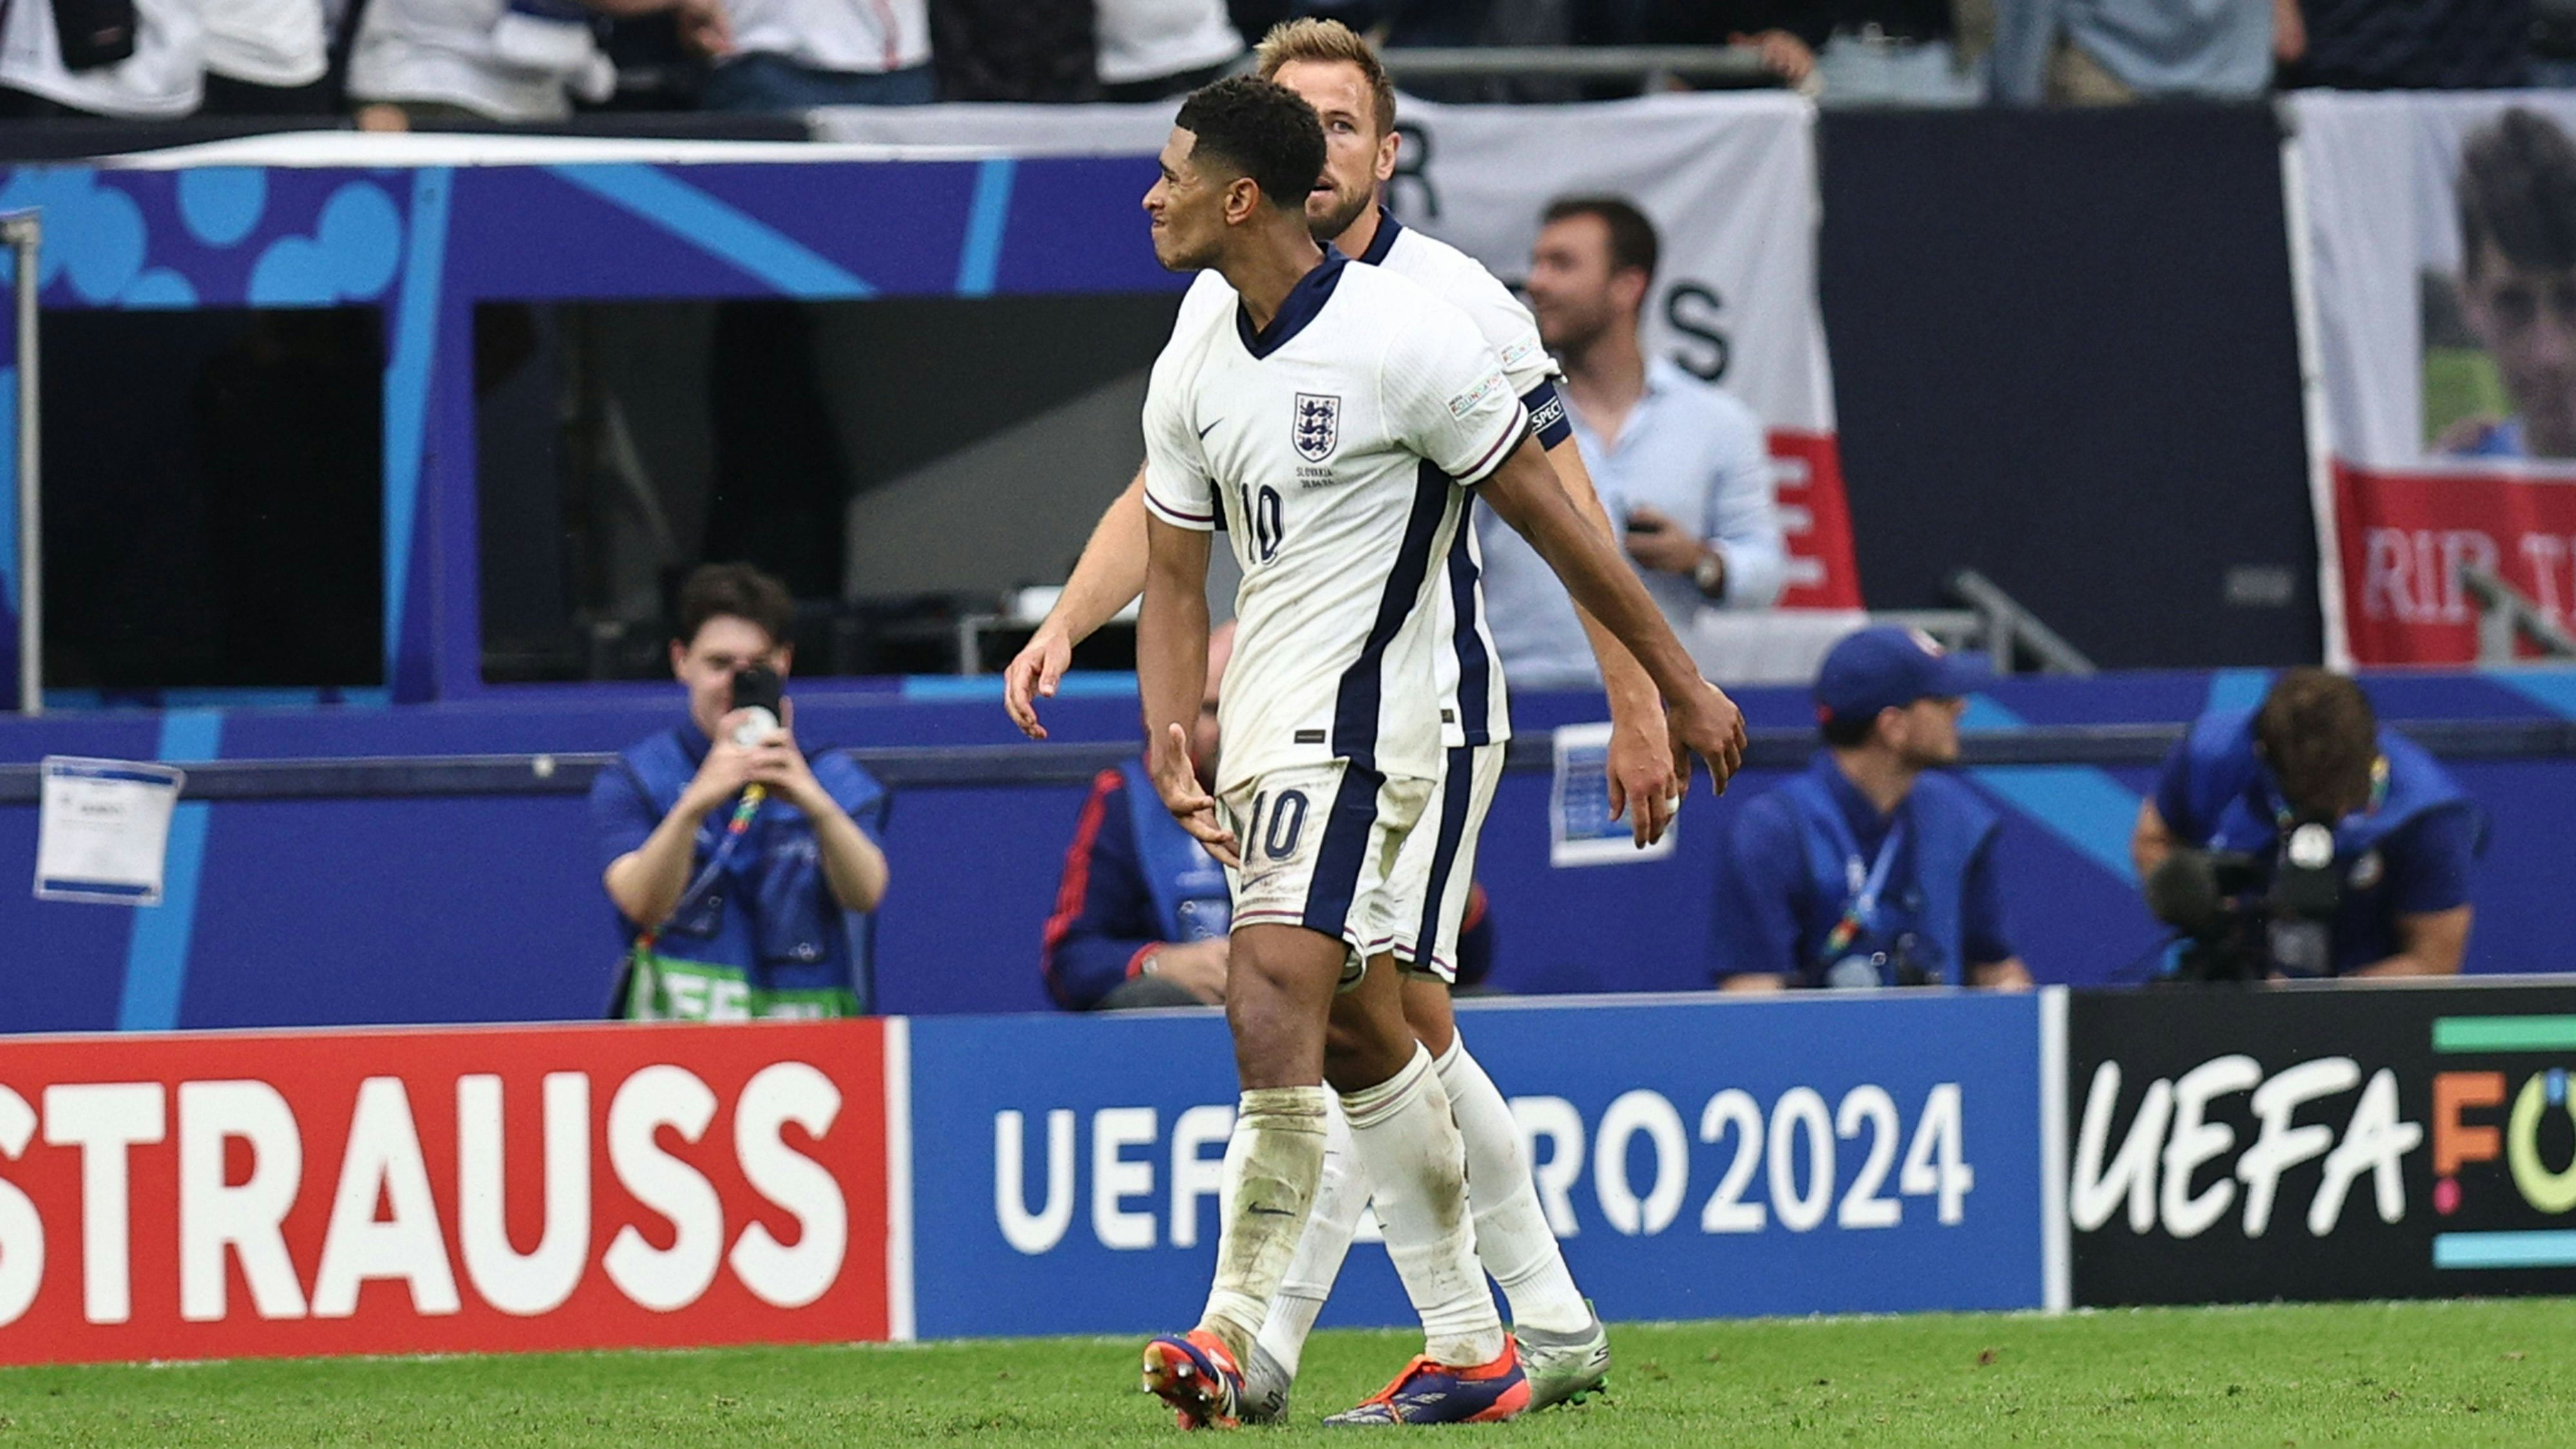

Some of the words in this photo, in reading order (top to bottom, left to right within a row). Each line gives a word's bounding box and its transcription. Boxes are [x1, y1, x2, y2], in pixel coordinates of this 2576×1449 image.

[1665, 278, 1731, 384] S
[1531, 399, 1562, 430] SPECT
[1241, 482, 1284, 564] 10
[2362, 526, 2499, 625] RIP
[2519, 531, 2576, 634] T
[1244, 789, 1309, 864] 10
[994, 1104, 1234, 1255] UEF
[2070, 1054, 2423, 1239] UEFA
